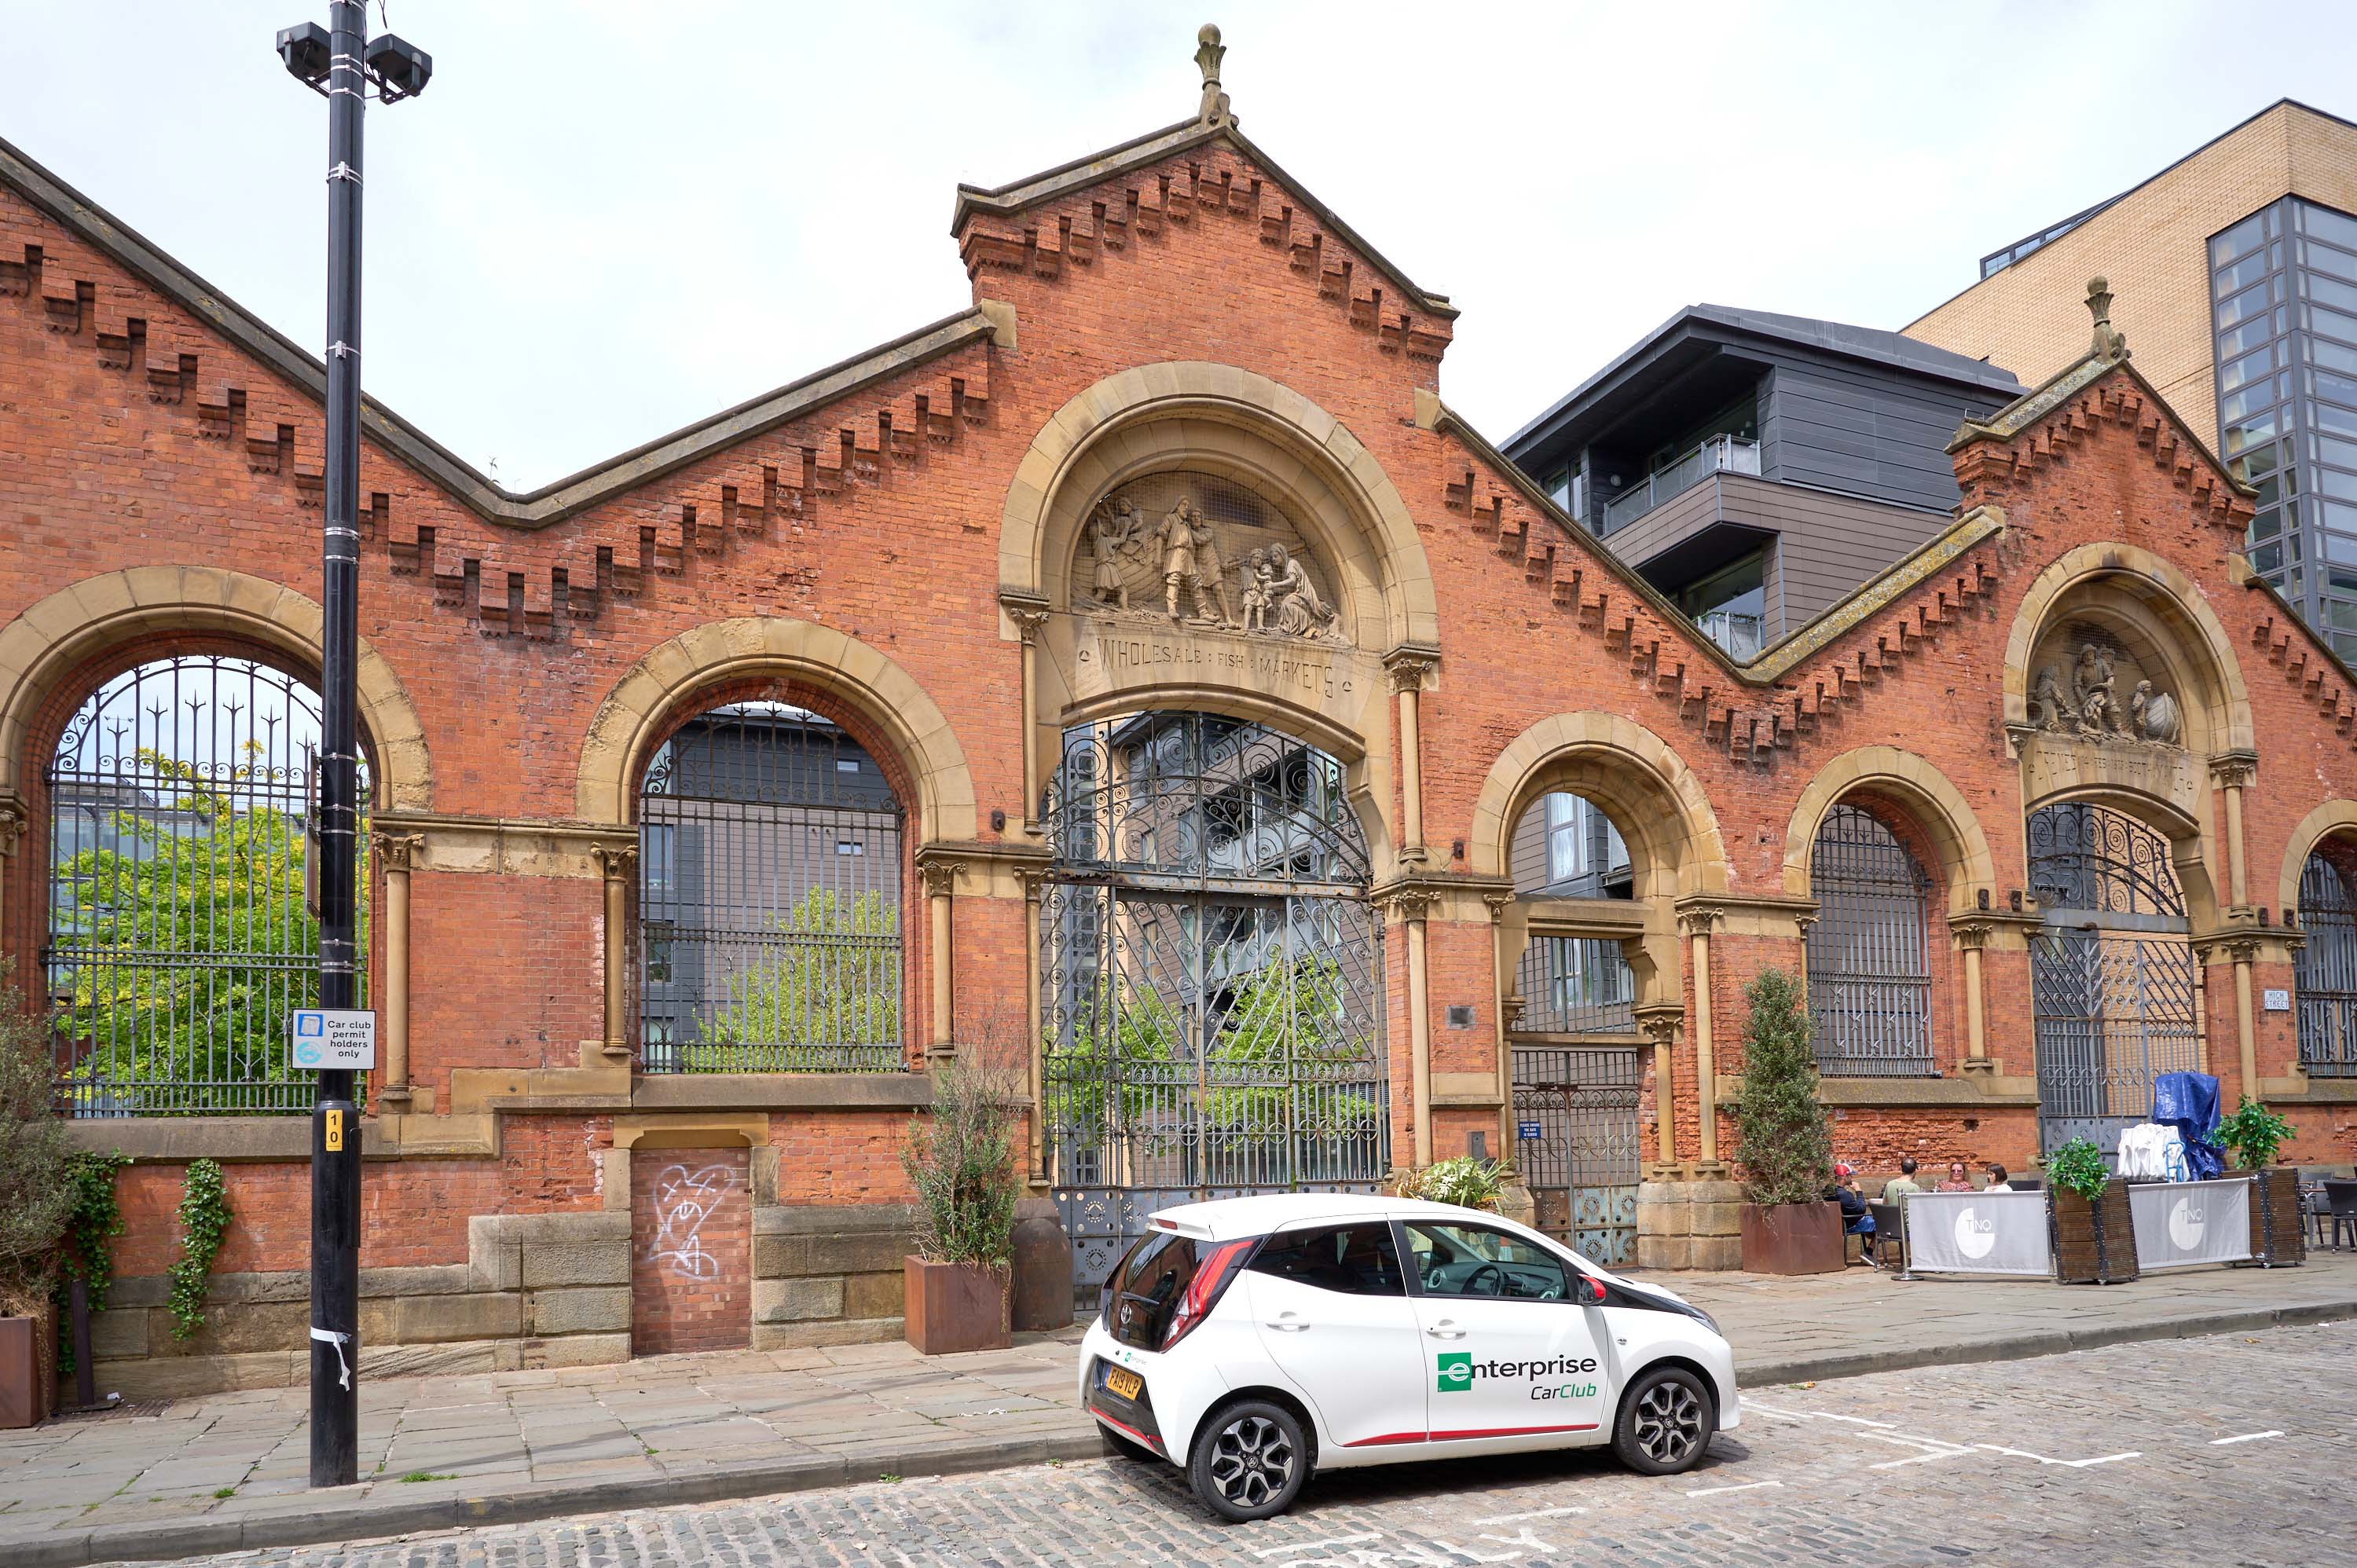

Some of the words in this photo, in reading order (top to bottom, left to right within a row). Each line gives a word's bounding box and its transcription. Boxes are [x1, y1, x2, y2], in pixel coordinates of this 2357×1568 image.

[1098, 638, 1201, 672] WHOLESALE
[1218, 654, 1244, 669] FISH
[1259, 658, 1333, 699] MARKETS
[2265, 1000, 2289, 1009] STREET
[330, 1039, 368, 1048] holders
[338, 1050, 360, 1059] only
[1447, 1354, 1597, 1382] enterprise
[1109, 1368, 1126, 1390] FA19
[1124, 1375, 1140, 1396] VLP
[1530, 1383, 1597, 1400] CarClub
